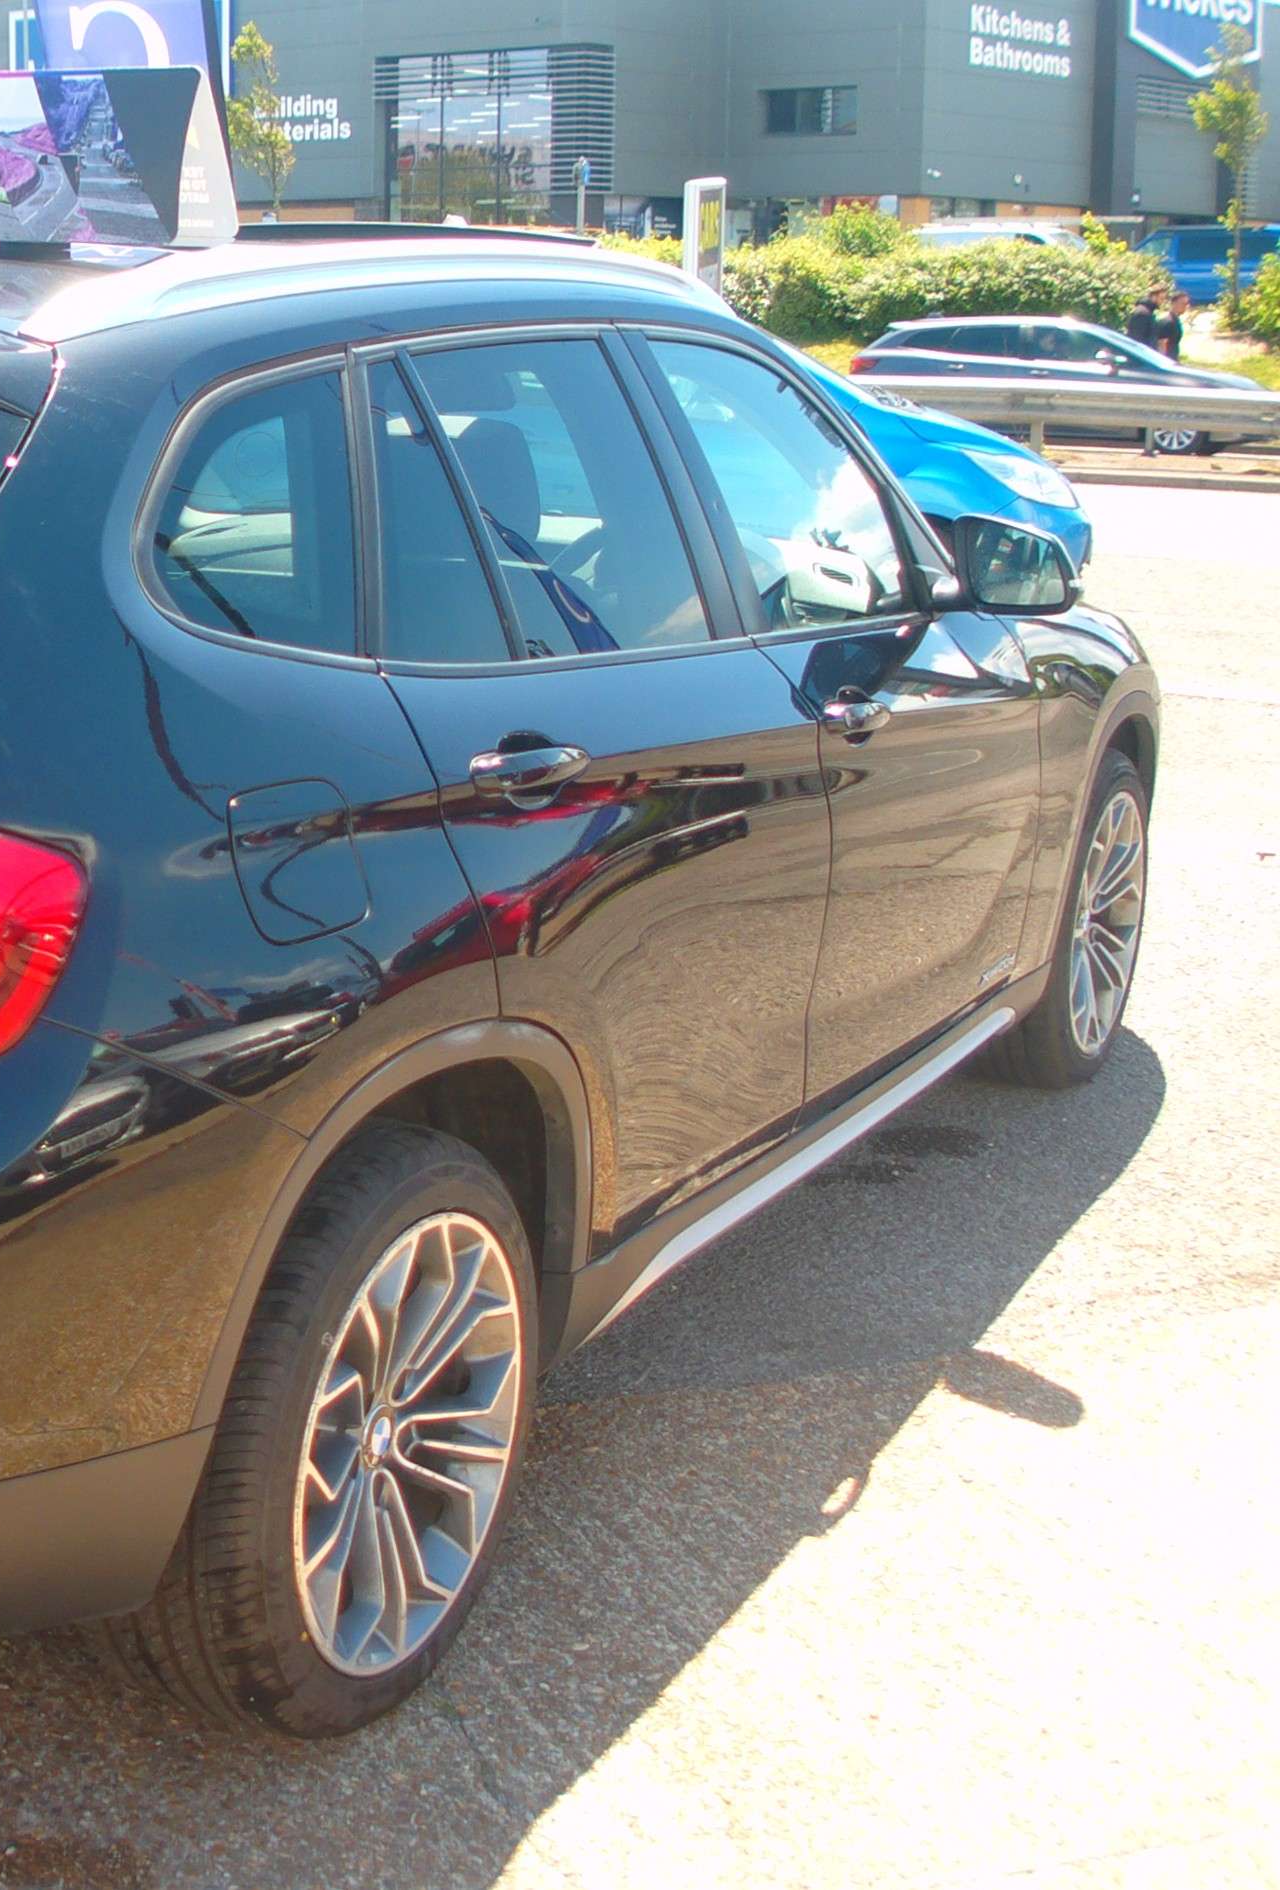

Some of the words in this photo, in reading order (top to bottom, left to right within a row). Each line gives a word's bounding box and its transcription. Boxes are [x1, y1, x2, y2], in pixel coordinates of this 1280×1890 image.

[971, 5, 1054, 43] Kitchens
[1056, 19, 1071, 46] &
[970, 37, 1071, 77] Bathrooms
